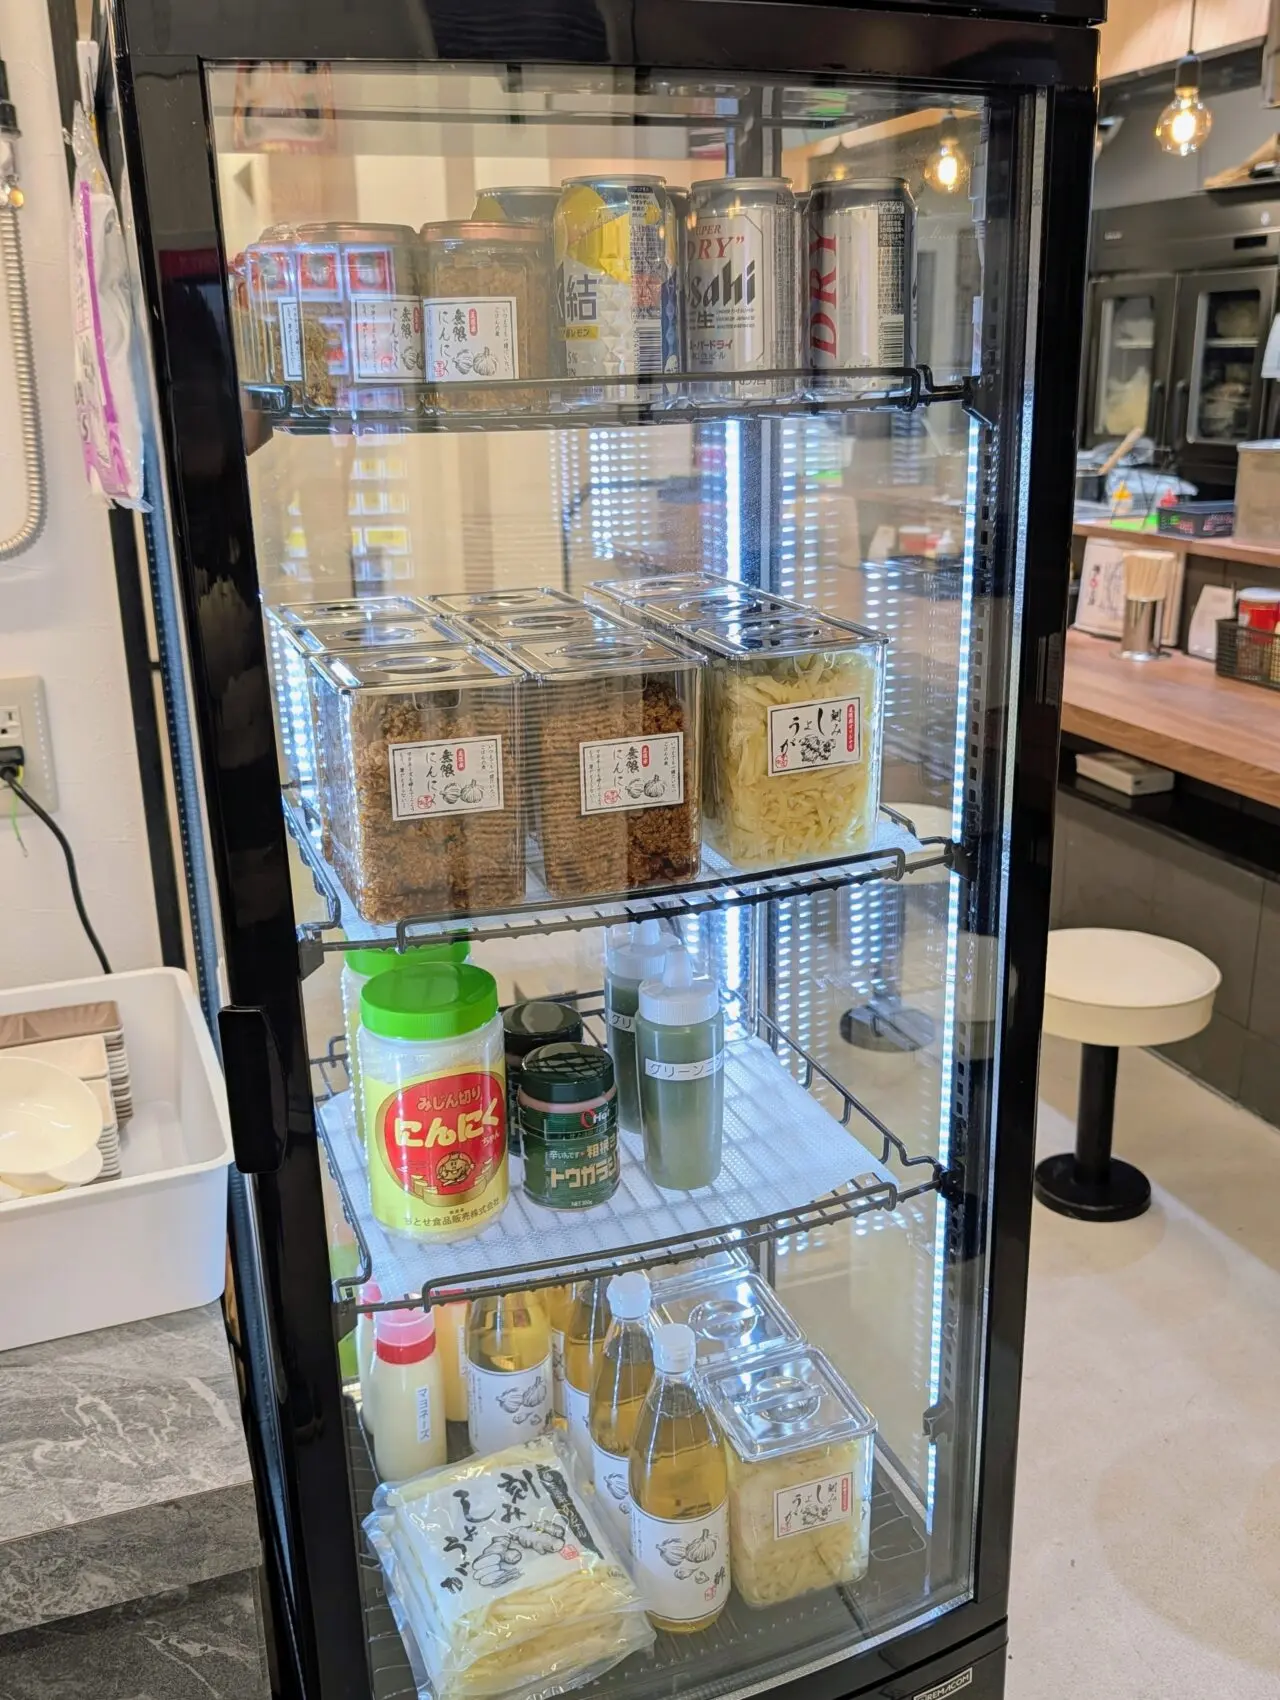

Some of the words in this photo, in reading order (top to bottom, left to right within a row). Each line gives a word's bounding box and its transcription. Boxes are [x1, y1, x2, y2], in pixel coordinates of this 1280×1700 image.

[809, 227, 837, 359] DRY
[395, 1098, 500, 1148] にんにく
[417, 1085, 482, 1112] みじん切り
